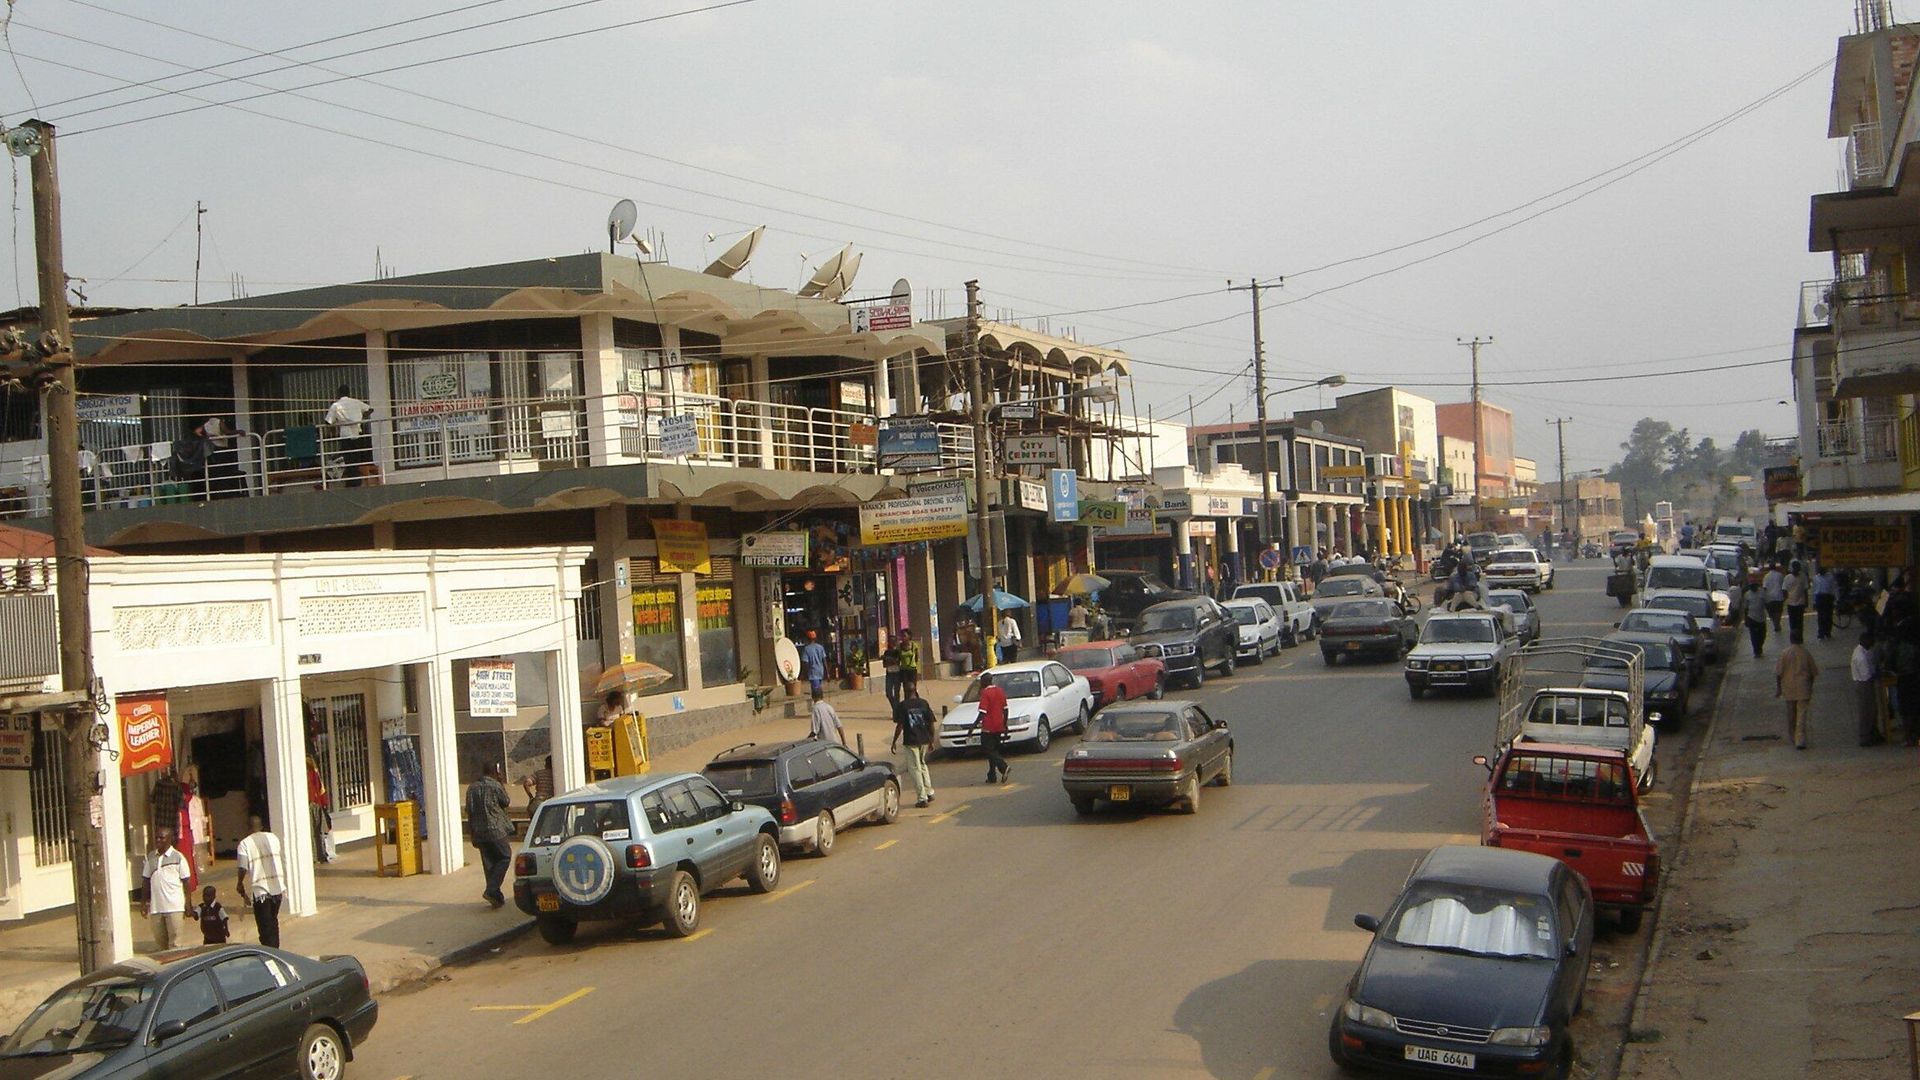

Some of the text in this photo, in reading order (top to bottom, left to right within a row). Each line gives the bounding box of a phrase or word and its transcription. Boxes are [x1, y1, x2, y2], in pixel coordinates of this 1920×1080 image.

[898, 431, 936, 439] MONEY POINT
[1020, 440, 1044, 449] CITY
[1008, 450, 1056, 461] CENTRE
[887, 499, 922, 509] PROFESSIONAL
[923, 497, 945, 506] DRIVING
[946, 495, 965, 504] SCHOOL
[1164, 500, 1188, 508] Bank
[912, 508, 929, 516] ROAD
[930, 506, 953, 514] SAFETY
[744, 556, 804, 566] INTERNET CAFE
[127, 716, 160, 735] IMPERIAL
[130, 728, 161, 746] LEATHER
[1417, 1048, 1469, 1067] UAG 664A
